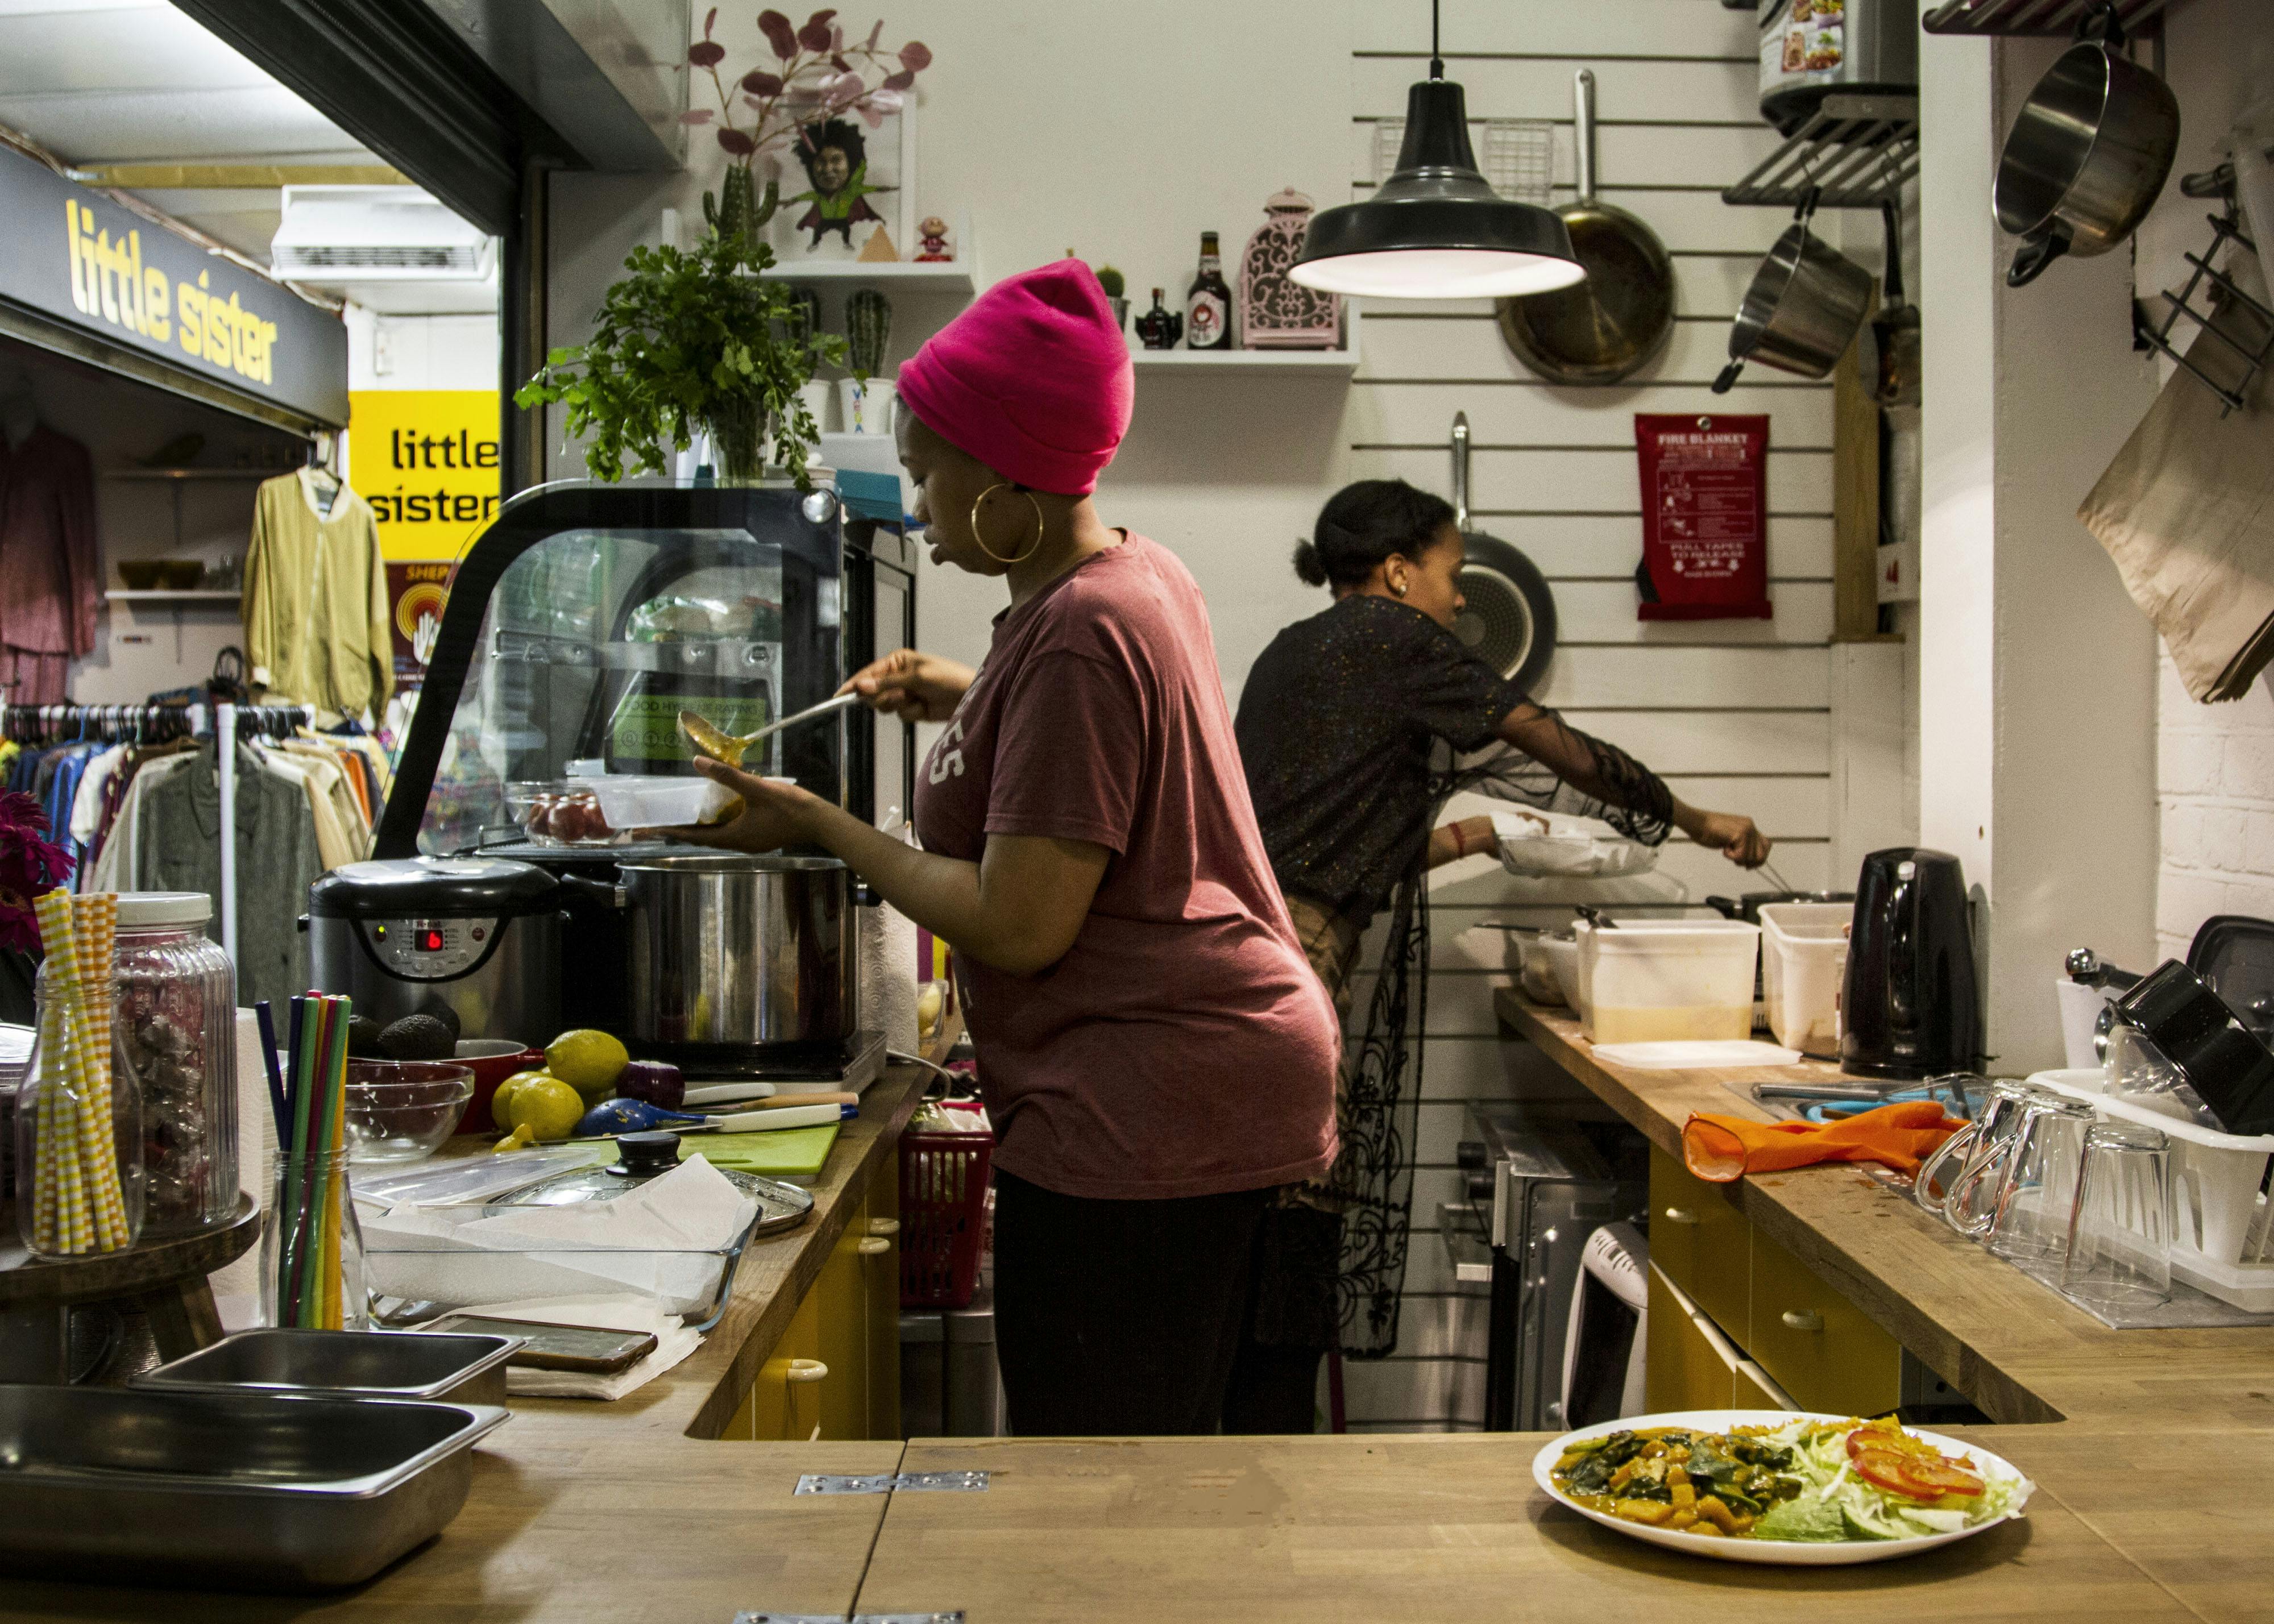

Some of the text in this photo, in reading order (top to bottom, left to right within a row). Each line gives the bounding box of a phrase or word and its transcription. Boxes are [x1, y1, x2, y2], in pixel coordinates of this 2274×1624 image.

[66, 198, 277, 386] little sister
[392, 429, 499, 468] little
[1658, 433, 1748, 445] FIRE BLANKET
[366, 485, 500, 522] sister
